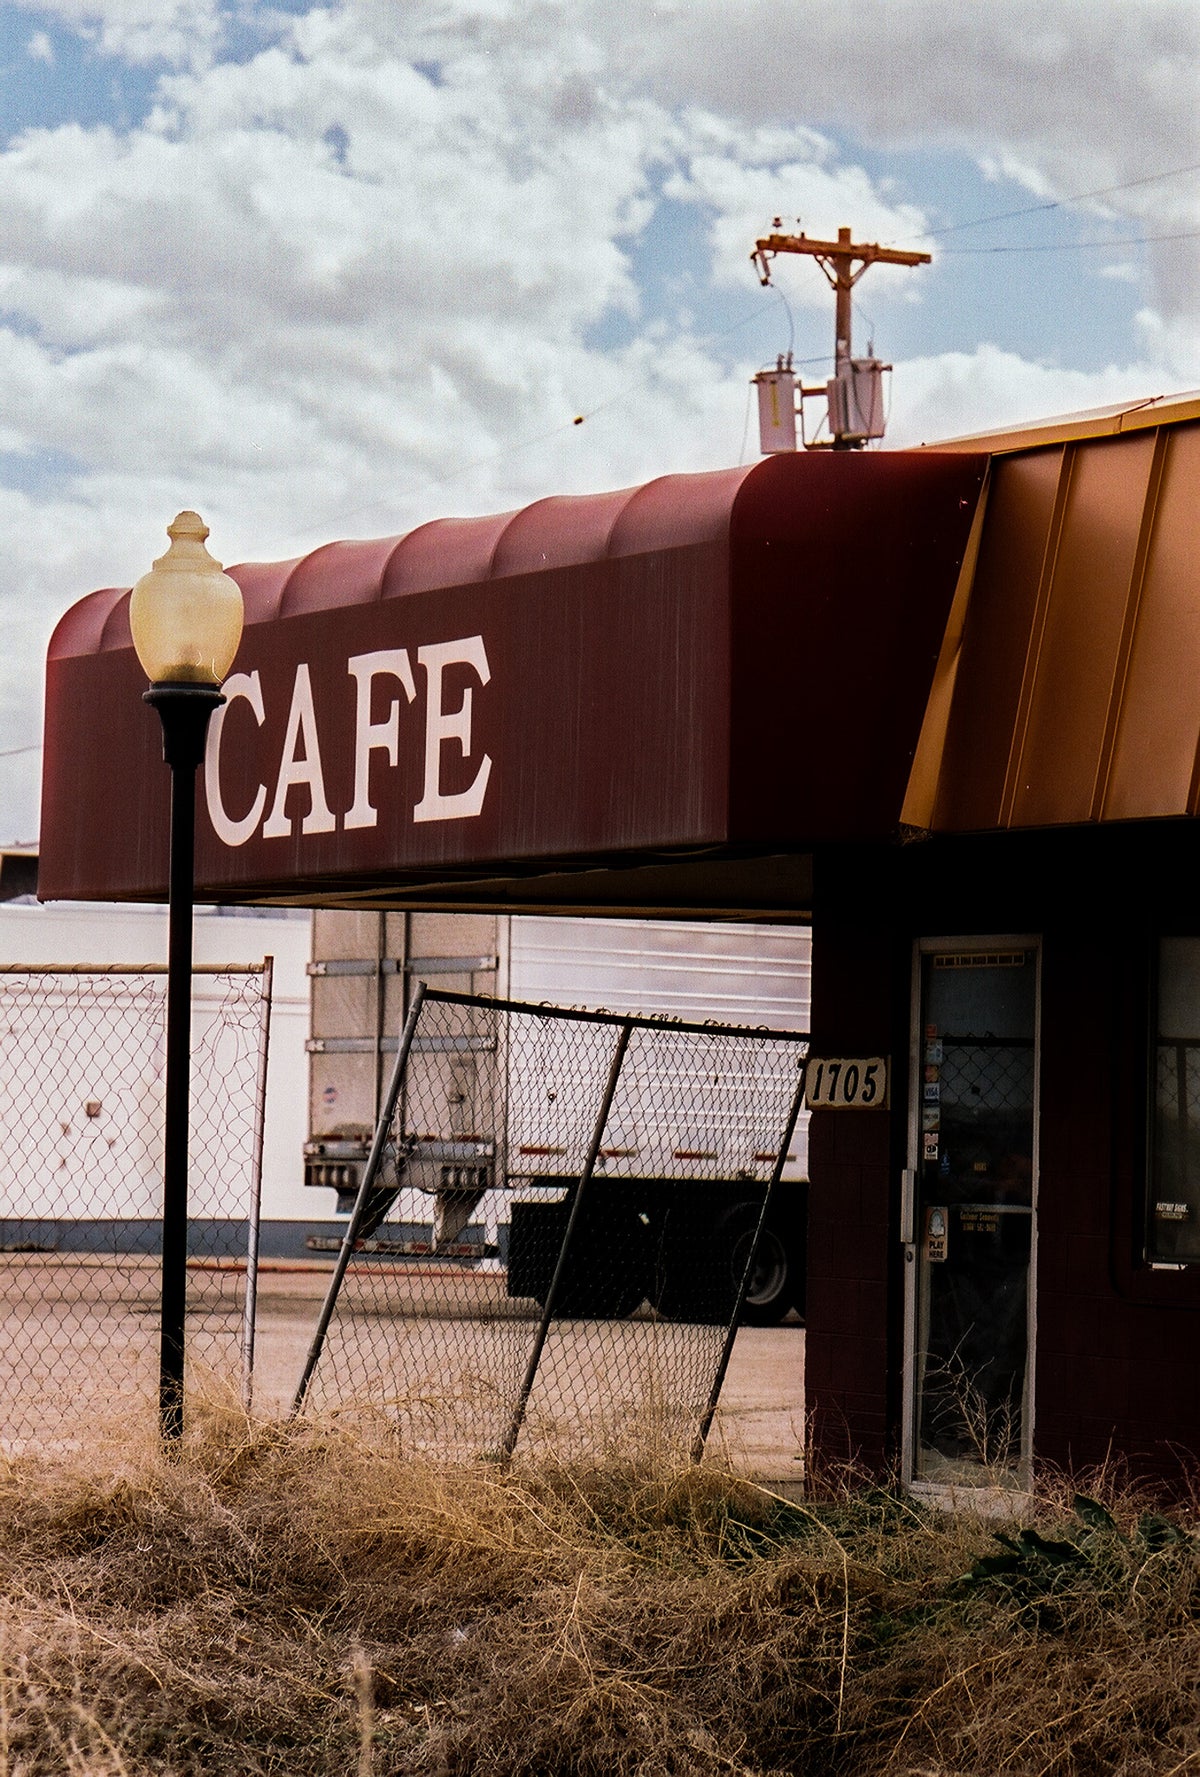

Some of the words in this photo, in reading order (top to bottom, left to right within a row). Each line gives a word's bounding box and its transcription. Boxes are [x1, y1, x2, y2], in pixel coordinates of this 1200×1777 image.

[205, 635, 492, 846] CAFE
[812, 1063, 878, 1102] 1705
[929, 1241, 944, 1249] PLAY
